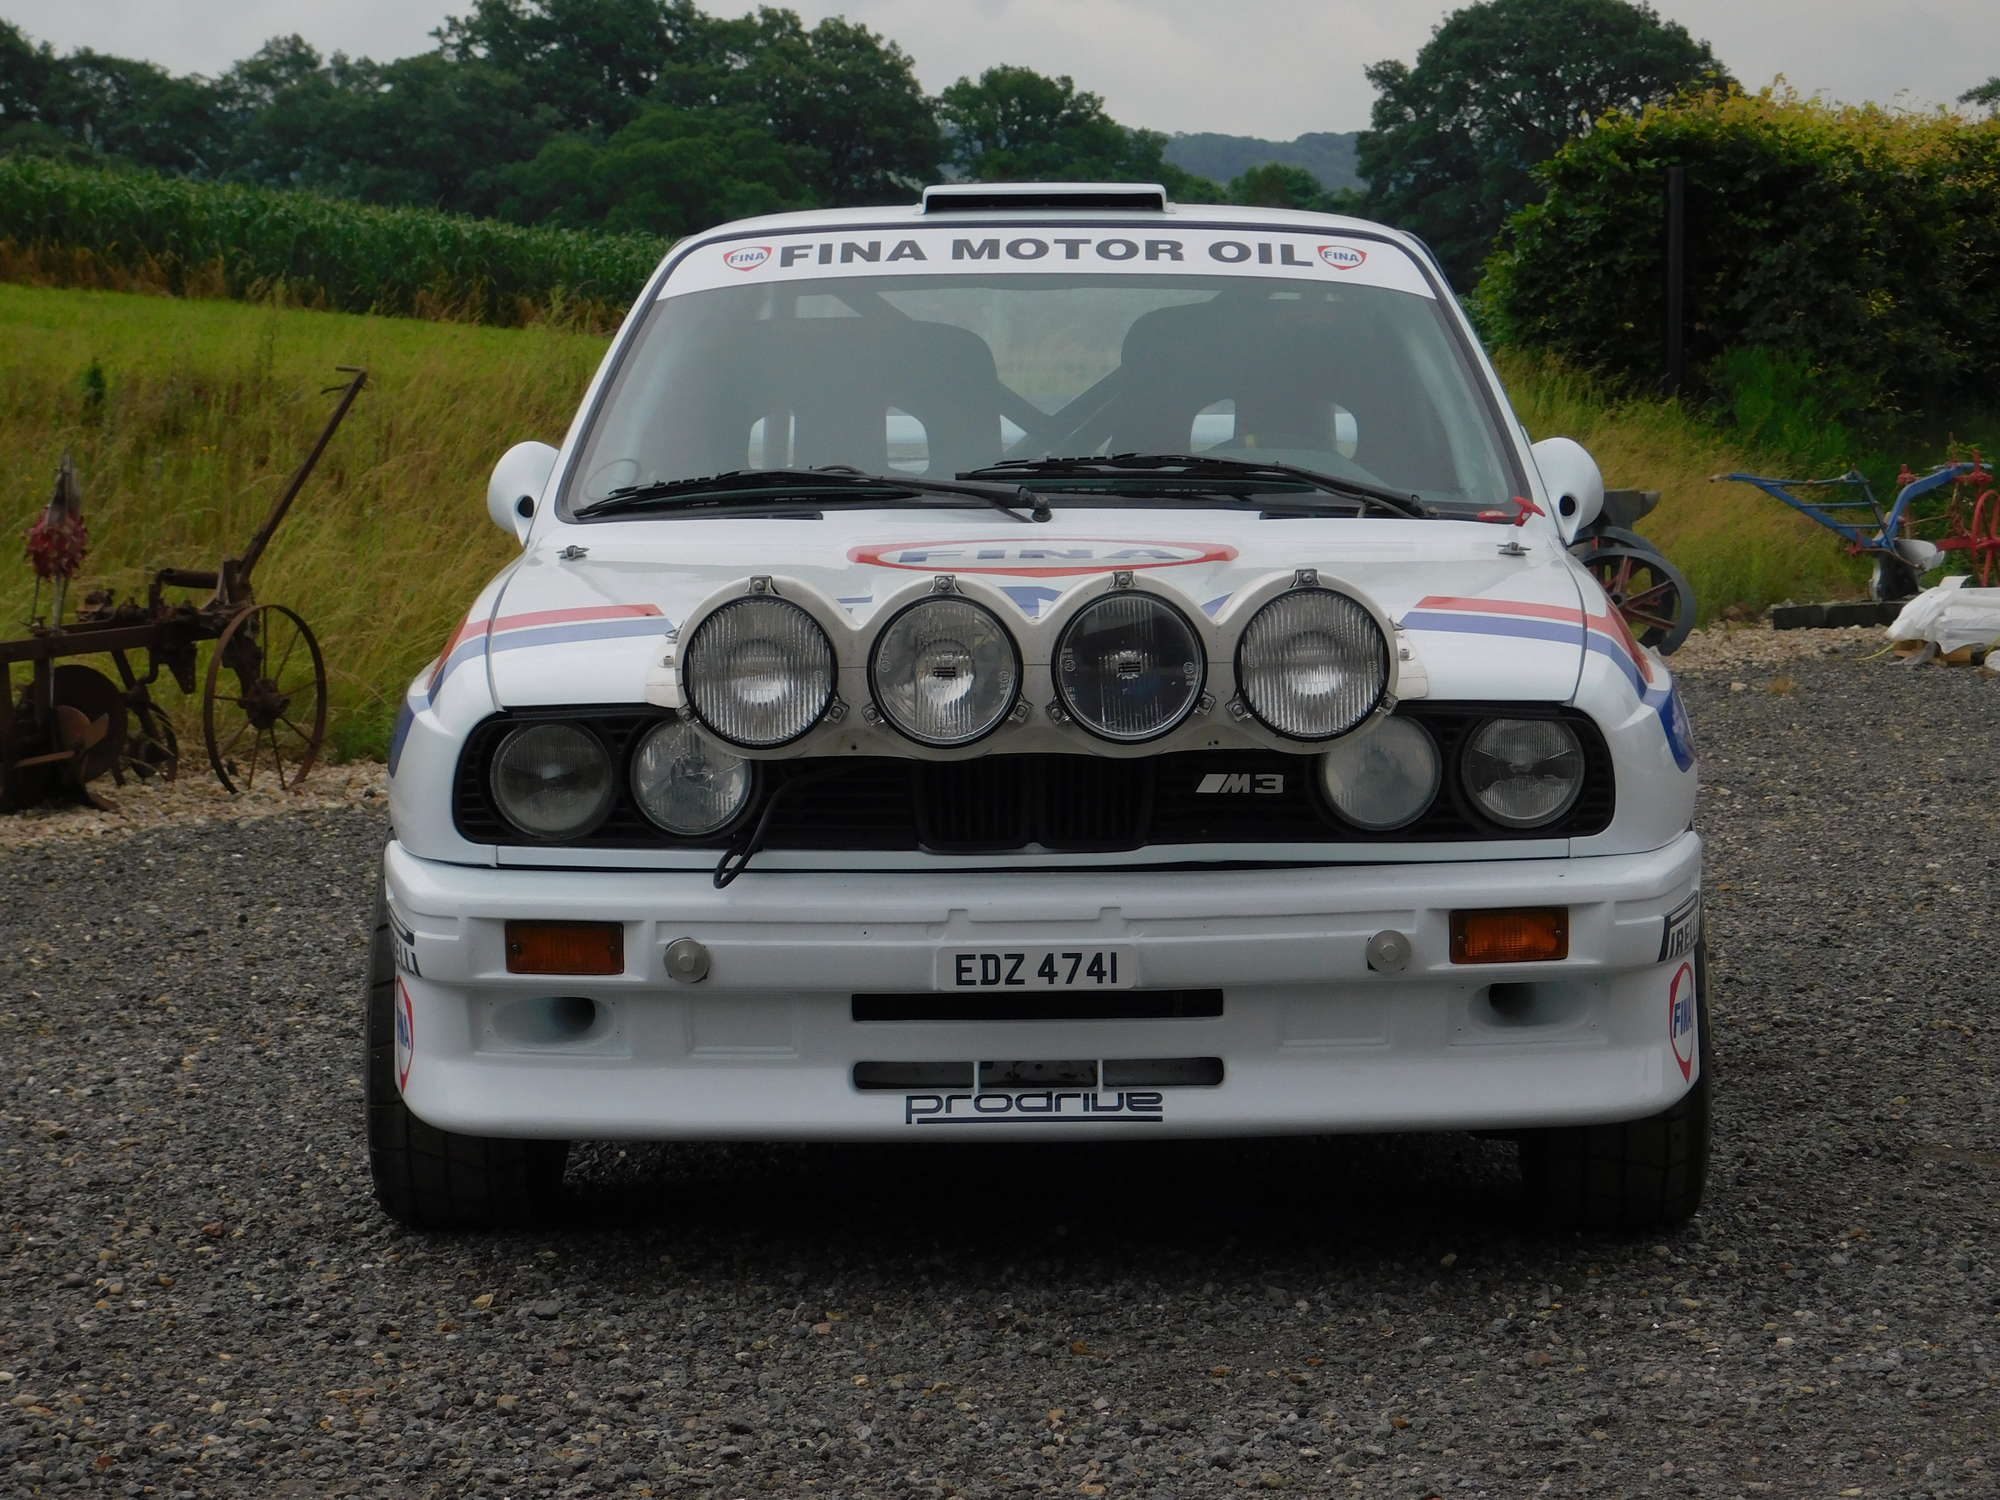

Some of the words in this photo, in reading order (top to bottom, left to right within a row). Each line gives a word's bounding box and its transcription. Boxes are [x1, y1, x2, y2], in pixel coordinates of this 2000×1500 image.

[730, 252, 764, 263] FINA
[779, 241, 928, 267] FINA
[951, 238, 1184, 261] MOTOR
[1207, 239, 1314, 267] OIL
[1323, 251, 1359, 262] FINA
[898, 549, 1184, 563] FINA
[955, 953, 1025, 986] EDZ
[1037, 952, 1117, 985] 4741
[905, 1091, 1163, 1124] prodrive
